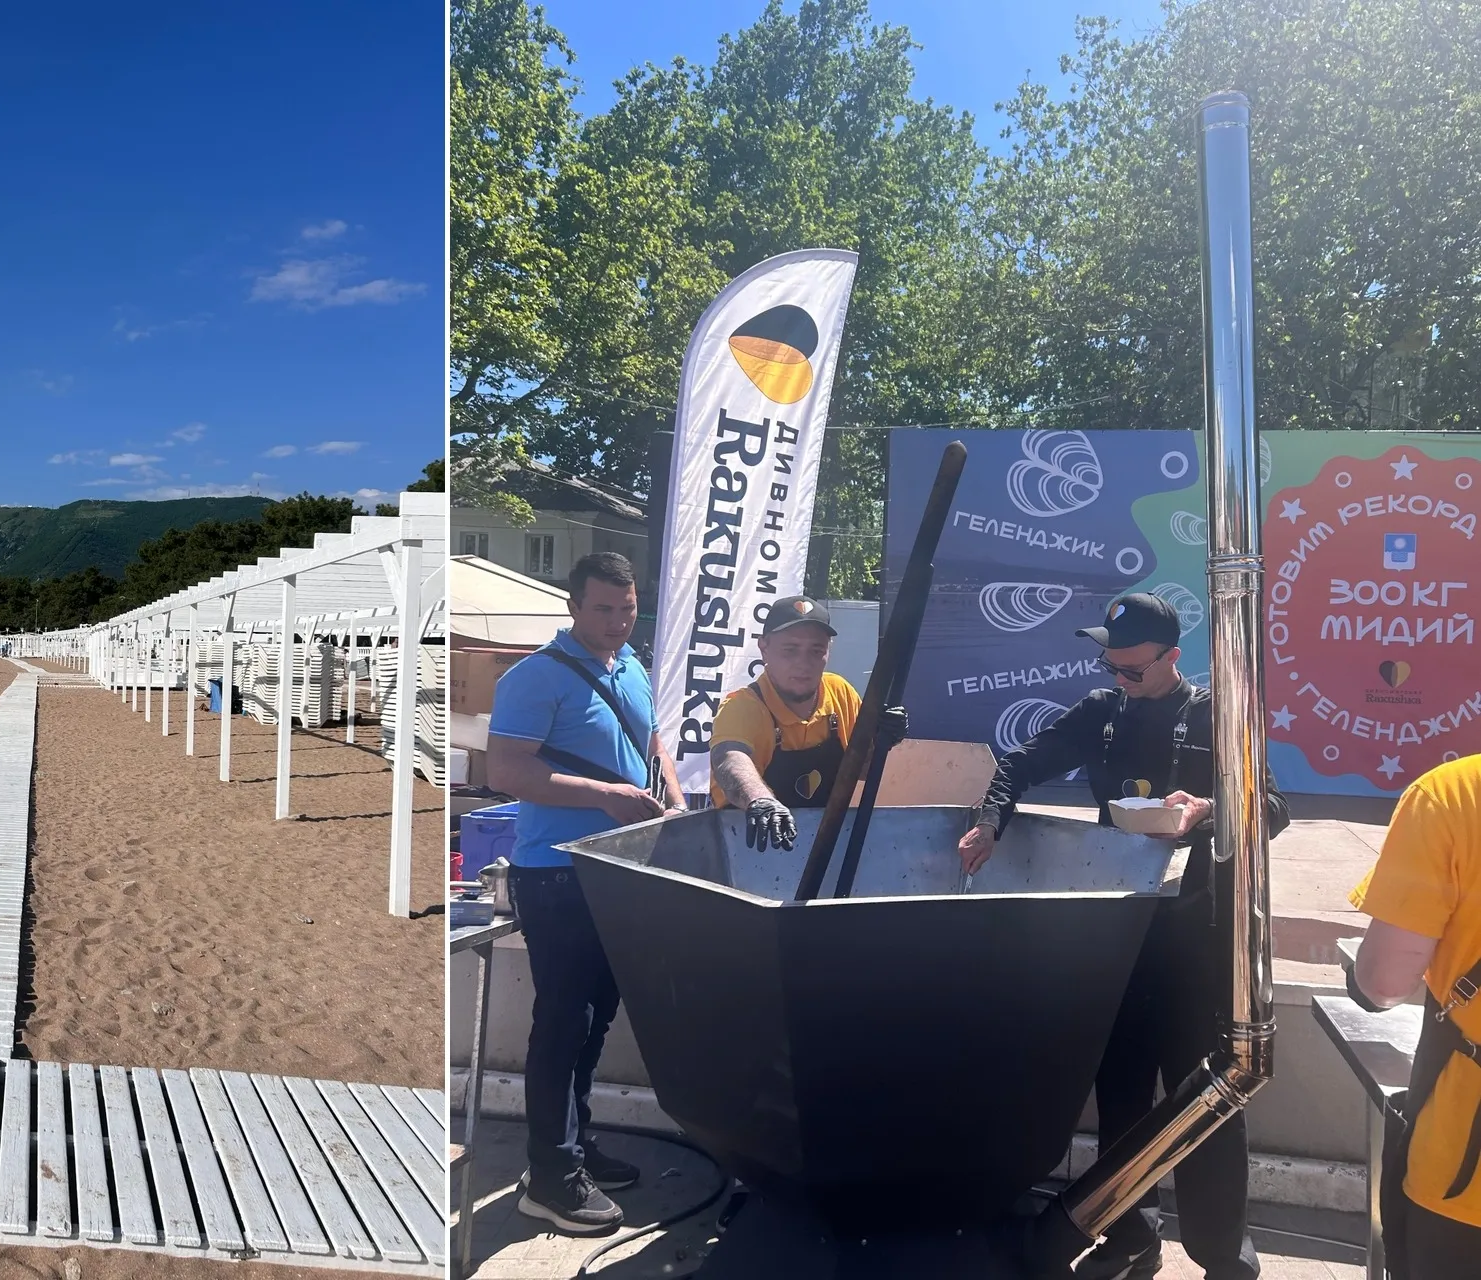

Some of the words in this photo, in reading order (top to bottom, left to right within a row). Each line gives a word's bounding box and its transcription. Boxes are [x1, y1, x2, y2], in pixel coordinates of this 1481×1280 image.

[953, 511, 1106, 560] ГЕЛЕНДЖИК
[676, 408, 770, 761] Rakushka
[1268, 521, 1335, 665] ГОТОВИМ
[1337, 494, 1477, 540] РЕКОРД
[1320, 612, 1475, 647] МИДИЙ
[947, 657, 1101, 696] ГЕЛЕНДЖИК
